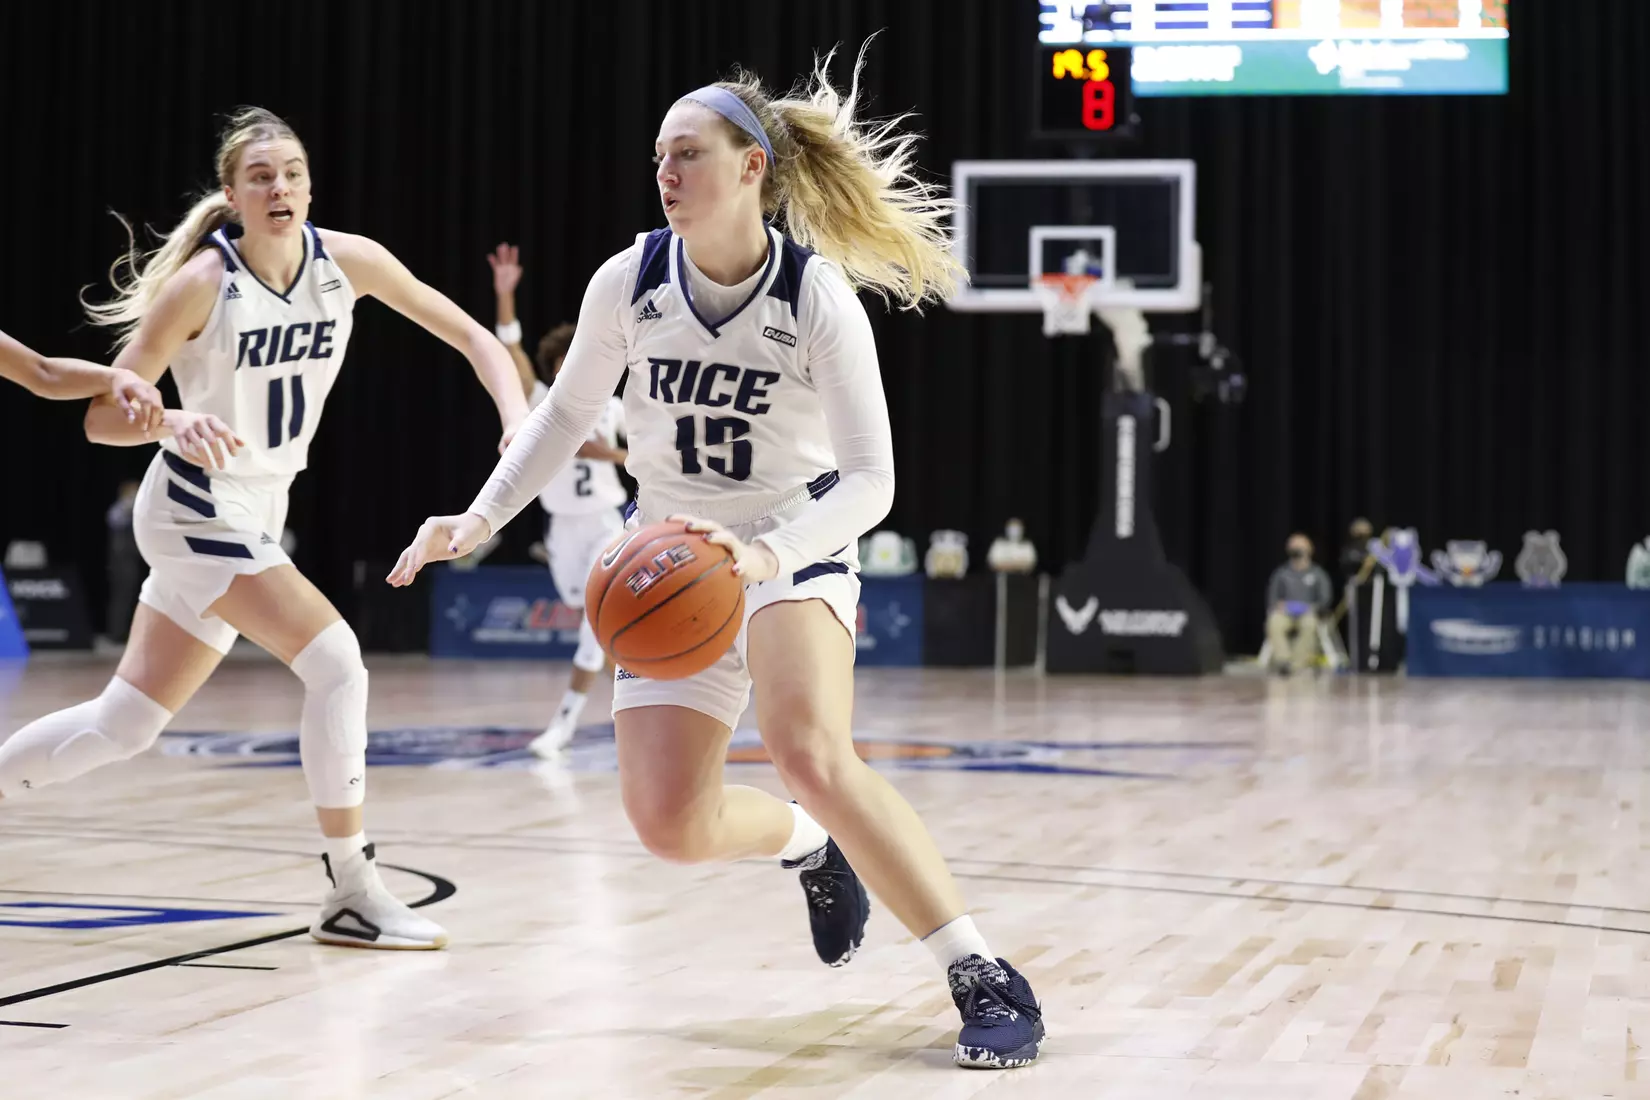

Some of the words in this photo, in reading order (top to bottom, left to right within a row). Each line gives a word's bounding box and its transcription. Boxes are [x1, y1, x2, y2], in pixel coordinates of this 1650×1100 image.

[1082, 79, 1115, 131] 8
[235, 319, 336, 371] RICE
[267, 373, 306, 449] 11
[647, 357, 781, 416] RICE
[675, 415, 753, 482] 15
[574, 463, 593, 498] 2
[625, 543, 697, 597] ELITE
